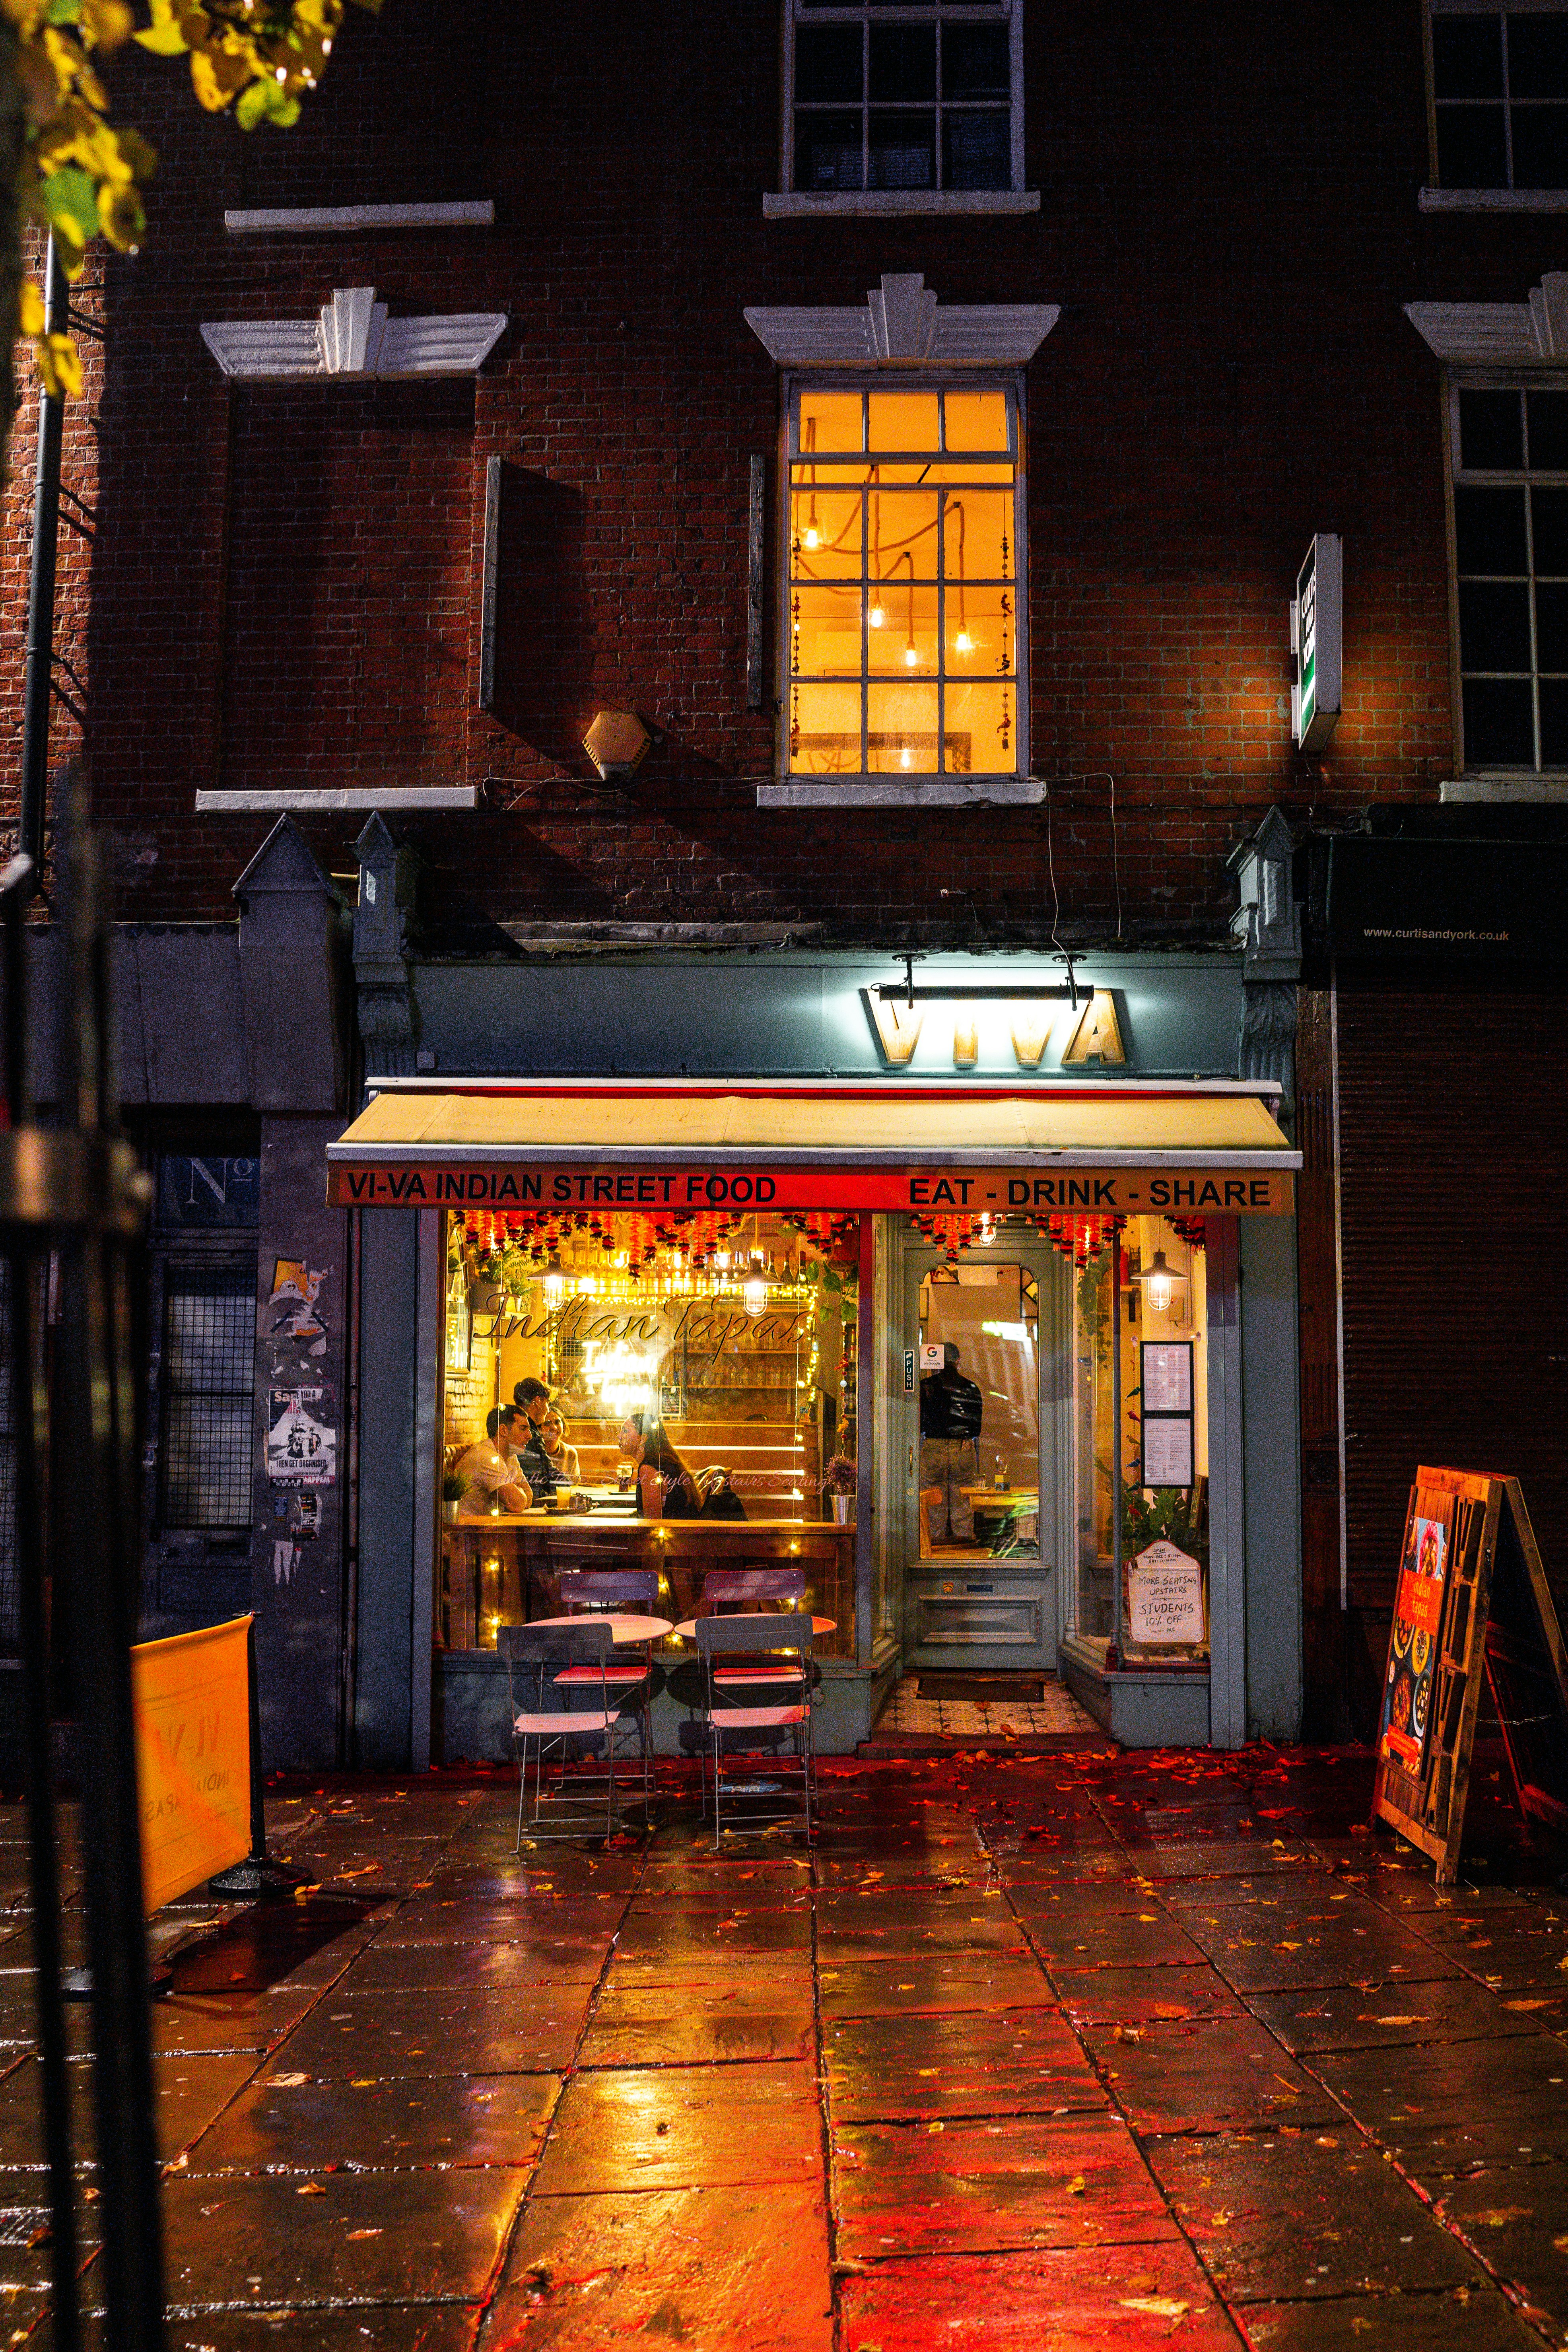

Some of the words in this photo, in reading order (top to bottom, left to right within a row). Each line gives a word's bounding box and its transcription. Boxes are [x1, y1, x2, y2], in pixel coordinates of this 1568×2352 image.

[1364, 928, 1510, 941] www.curtisandyork.co.uk
[865, 987, 1127, 1066] VIVA
[347, 1172, 427, 1199] VI-VA
[436, 1174, 542, 1201] INDIAN
[552, 1174, 678, 1202] STREET
[686, 1175, 777, 1203] FOOD
[909, 1178, 975, 1205] EAT
[1008, 1179, 1117, 1206] DRINK
[1149, 1179, 1271, 1207] SHARE
[473, 1293, 660, 1348] Indian
[664, 1293, 815, 1365] Tapas
[767, 1471, 832, 1495] Seating
[1139, 1576, 1160, 1586] MORE
[1163, 1576, 1197, 1586] SEATING
[1150, 1586, 1187, 1596] UPSTAIRS
[1139, 1603, 1194, 1615] STUDENTS
[1146, 1616, 1162, 1626] 10%
[1167, 1615, 1182, 1625] OFF
[1412, 1596, 1428, 1621] tapas
